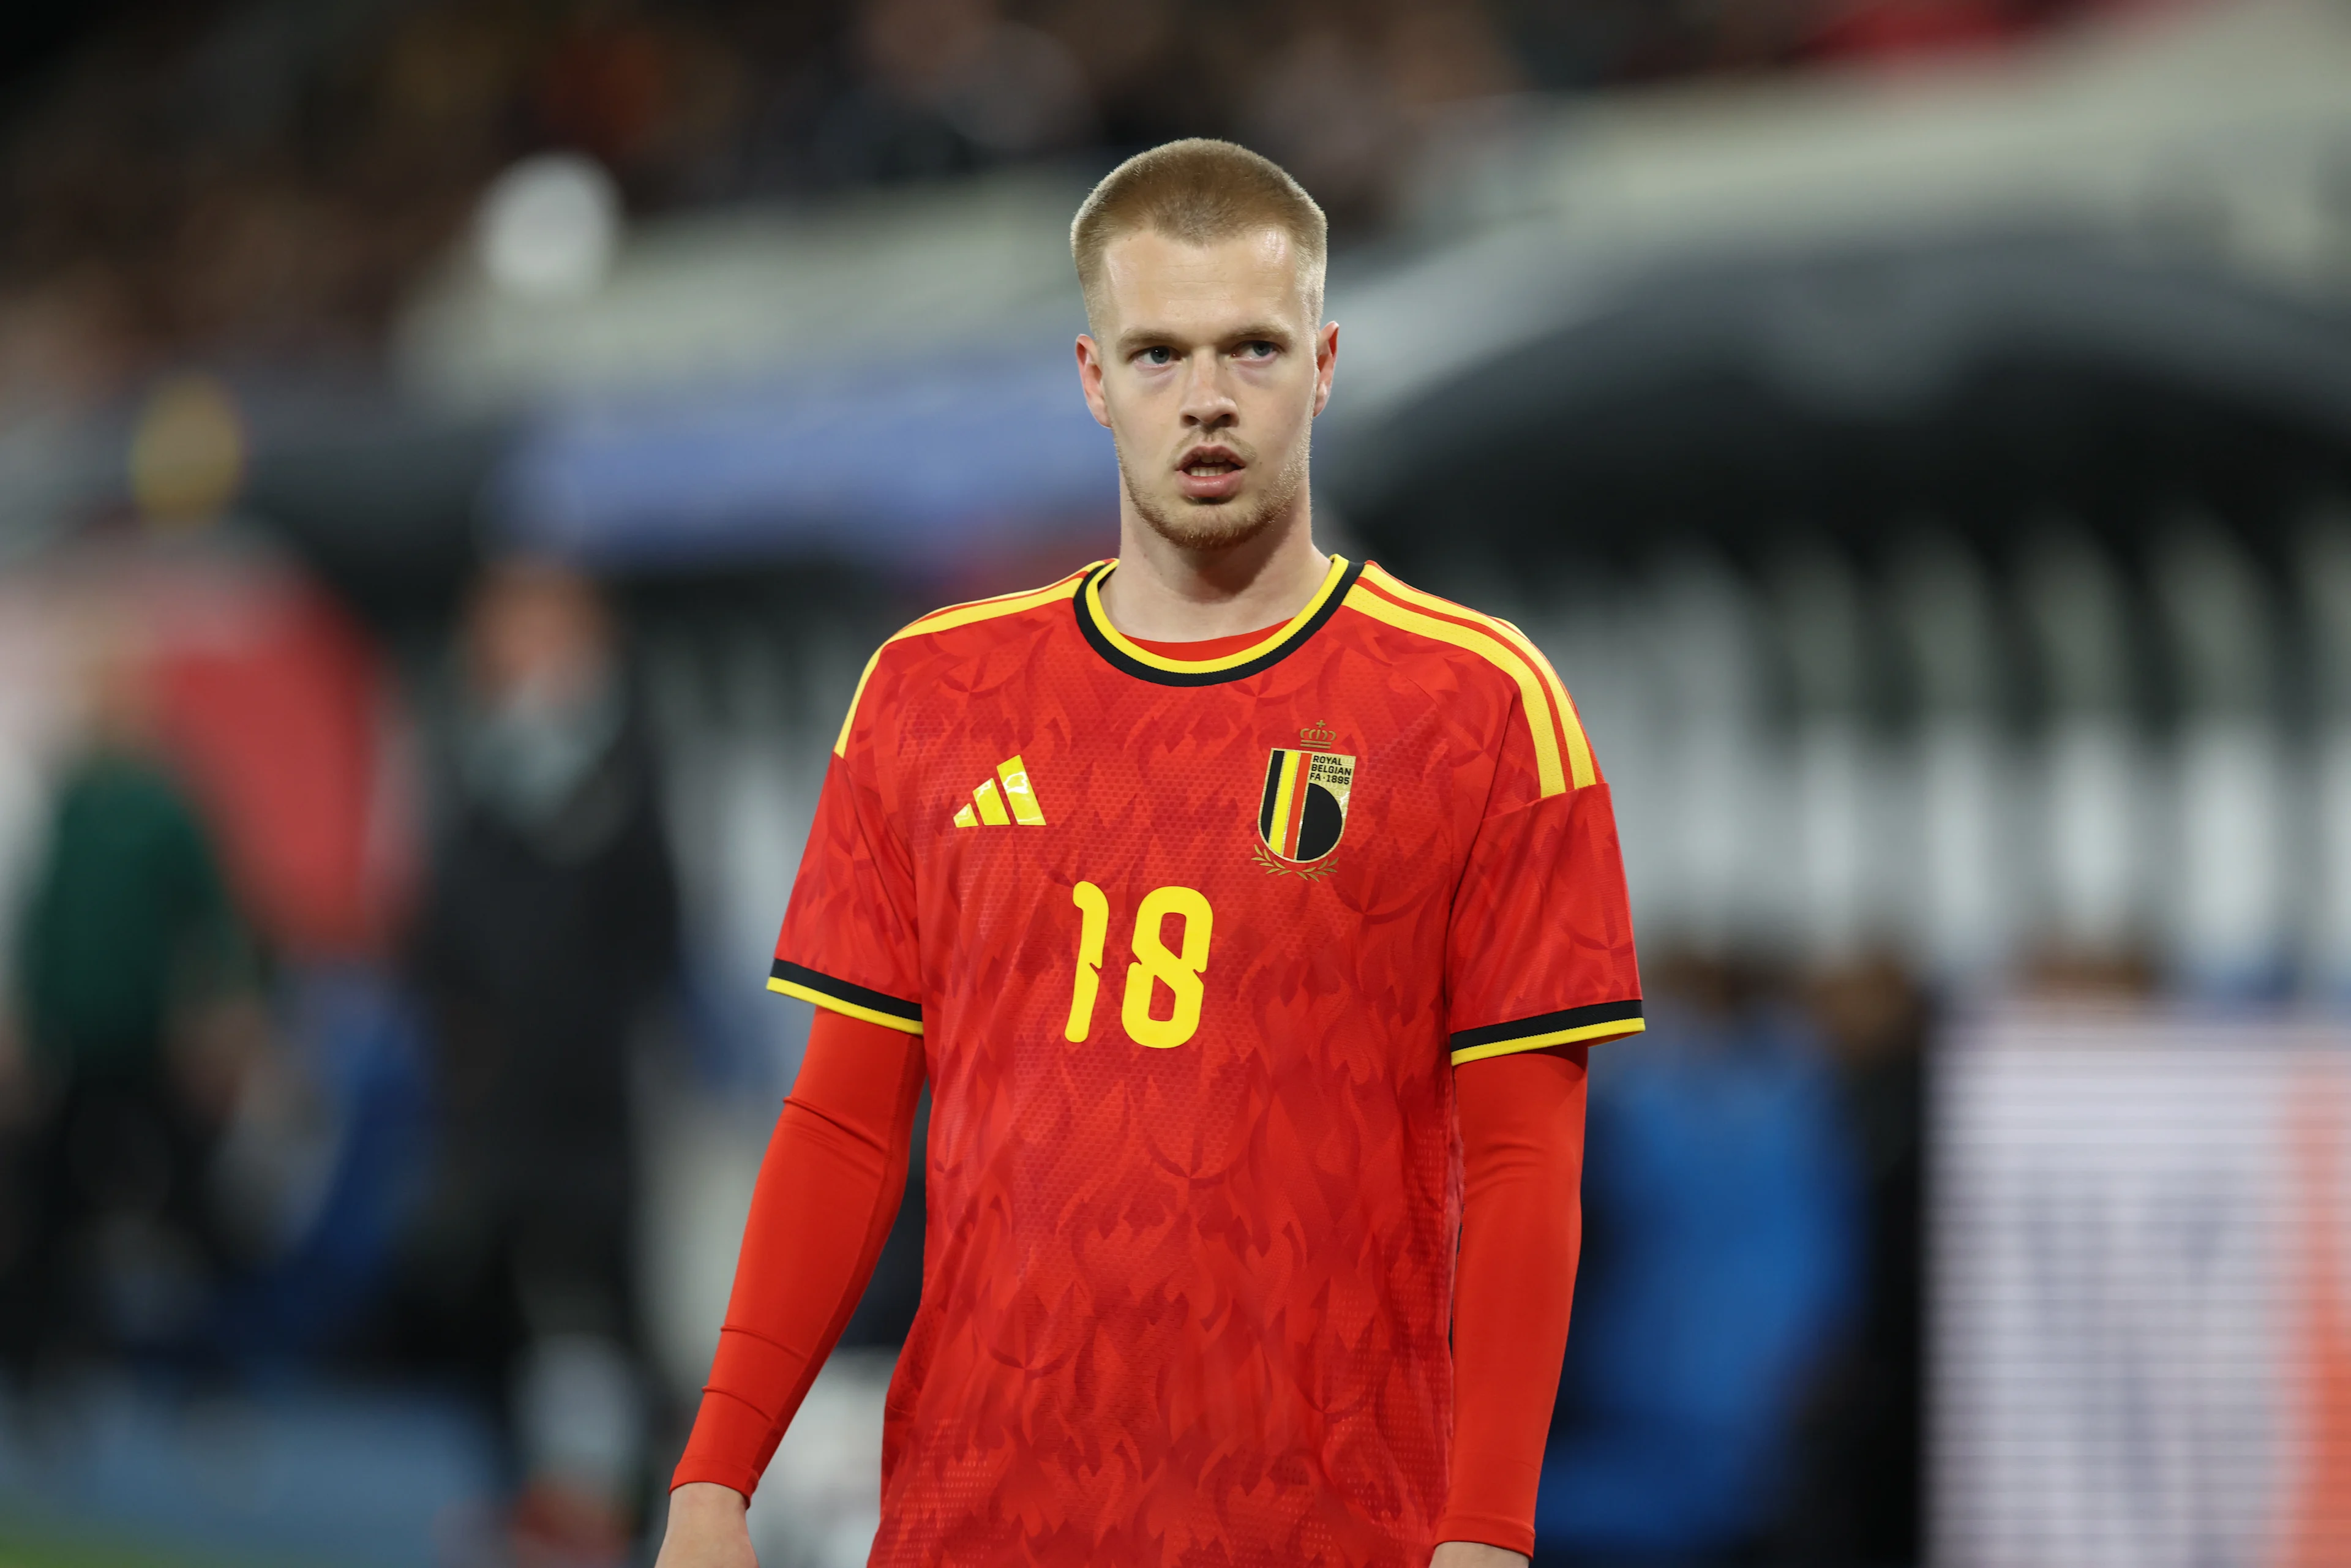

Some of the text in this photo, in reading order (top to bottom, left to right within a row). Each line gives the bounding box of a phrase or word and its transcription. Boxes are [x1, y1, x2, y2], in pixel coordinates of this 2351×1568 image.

[1313, 756, 1342, 765] ROYAL
[1311, 763, 1352, 776] BELGIAN
[1065, 881, 1213, 1049] 18
